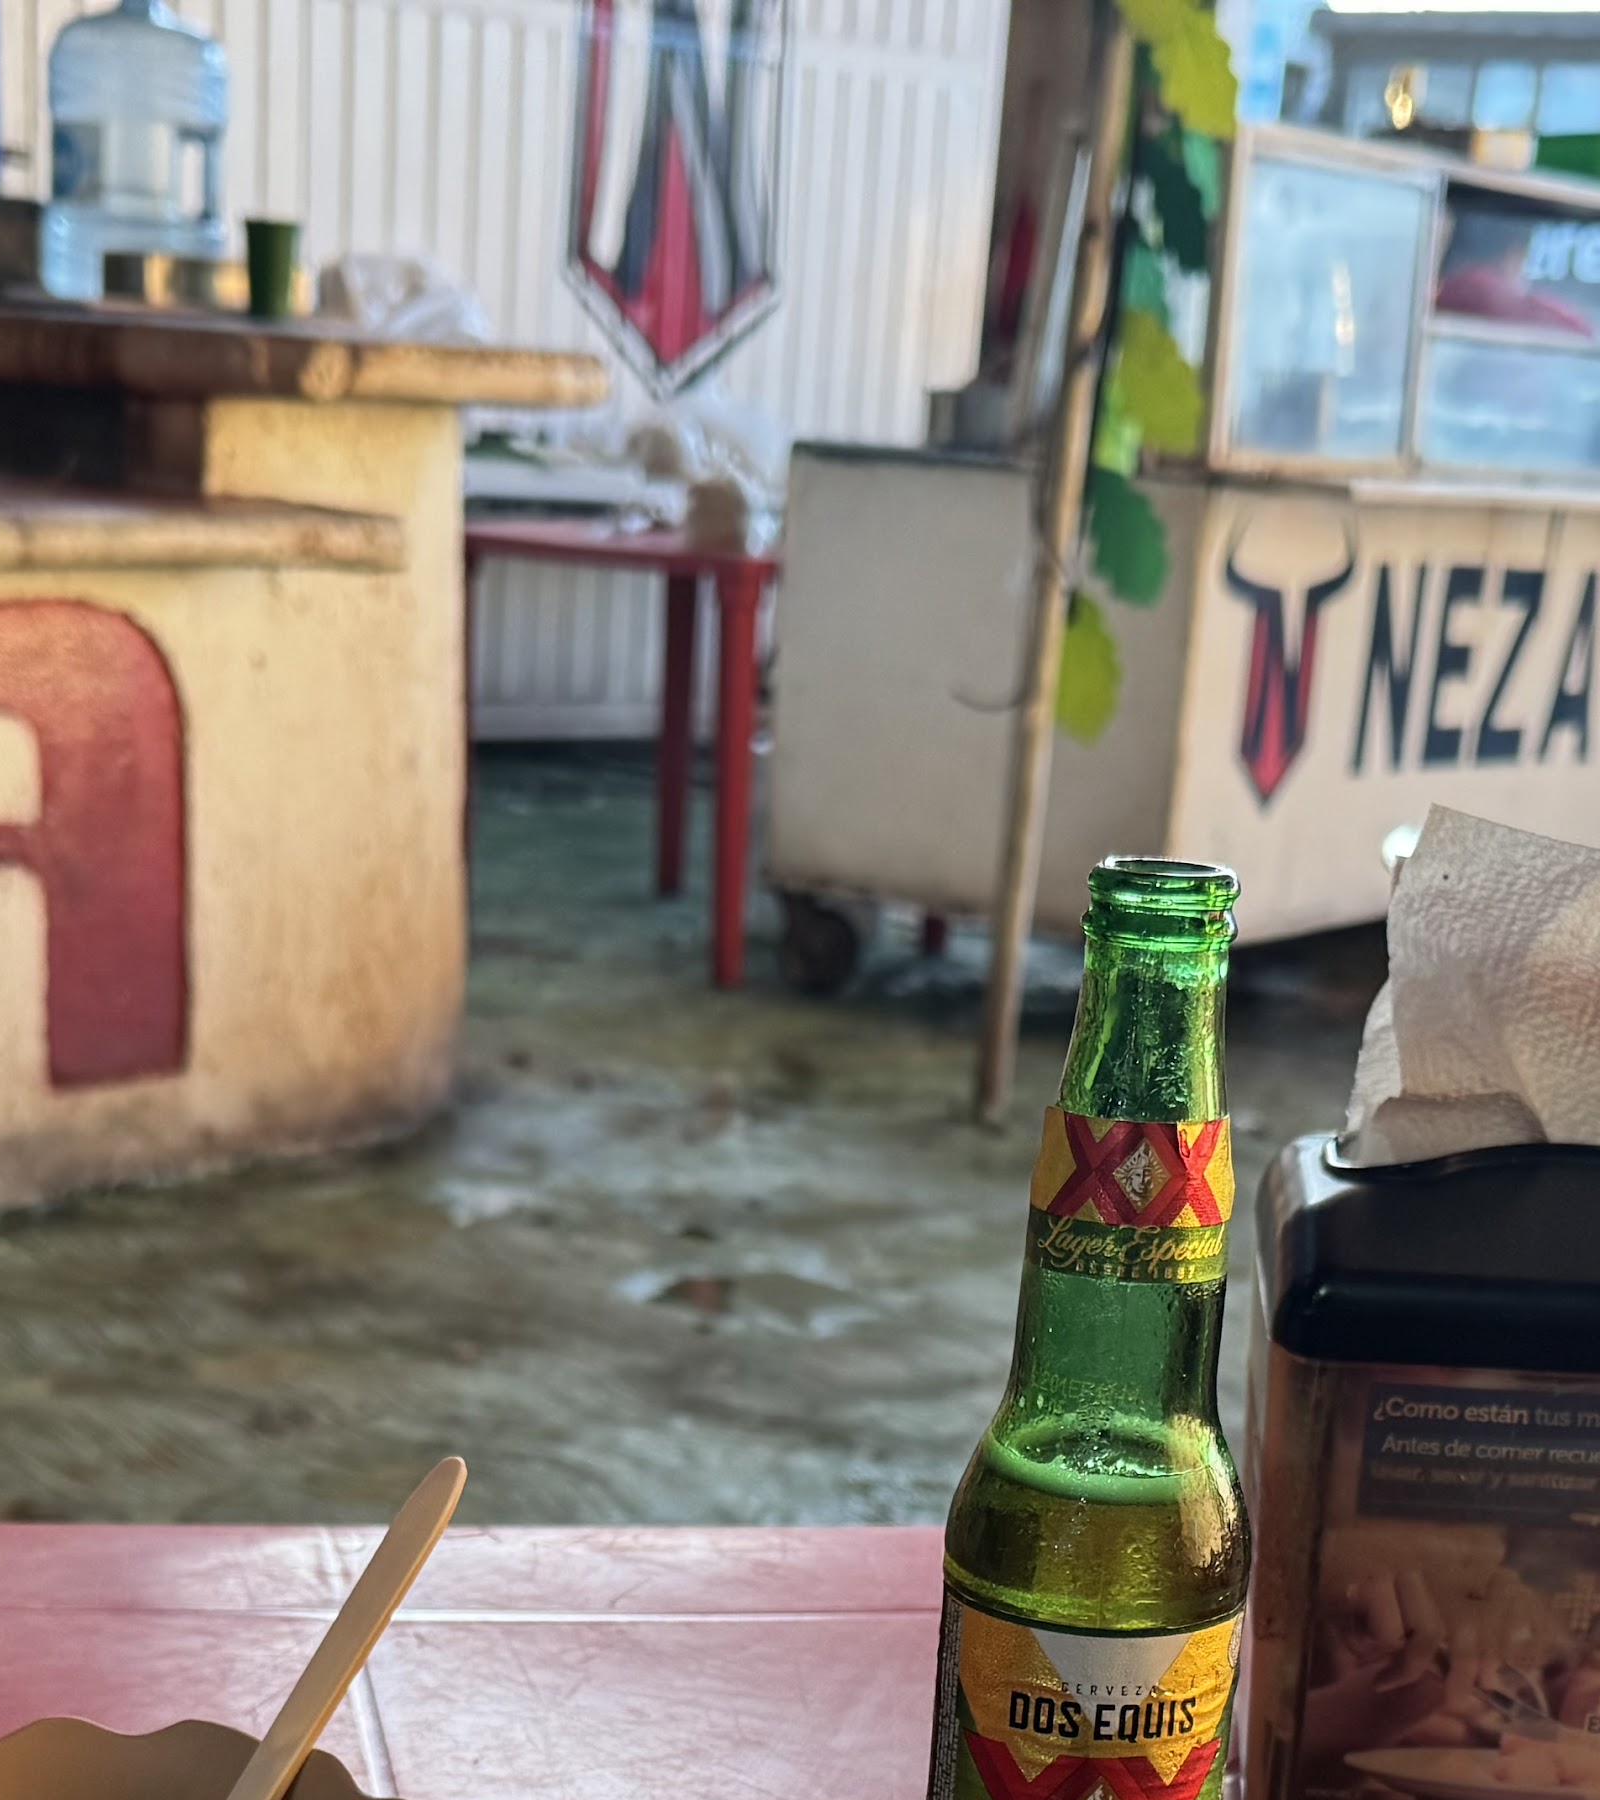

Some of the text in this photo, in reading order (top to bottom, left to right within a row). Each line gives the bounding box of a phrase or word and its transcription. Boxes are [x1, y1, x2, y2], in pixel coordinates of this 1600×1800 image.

[1350, 563, 1600, 776] NEZA
[1038, 1216, 1224, 1274] Lager Especial
[1373, 1396, 1460, 1422] ¿Como
[1464, 1404, 1530, 1425] están
[1534, 1407, 1571, 1428] tus
[1381, 1433, 1440, 1455] Antes
[1444, 1438, 1472, 1455] de
[1475, 1443, 1544, 1461] comer
[1061, 1682, 1159, 1698] CERVEZA
[1009, 1690, 1197, 1744] DOS EQUIS
